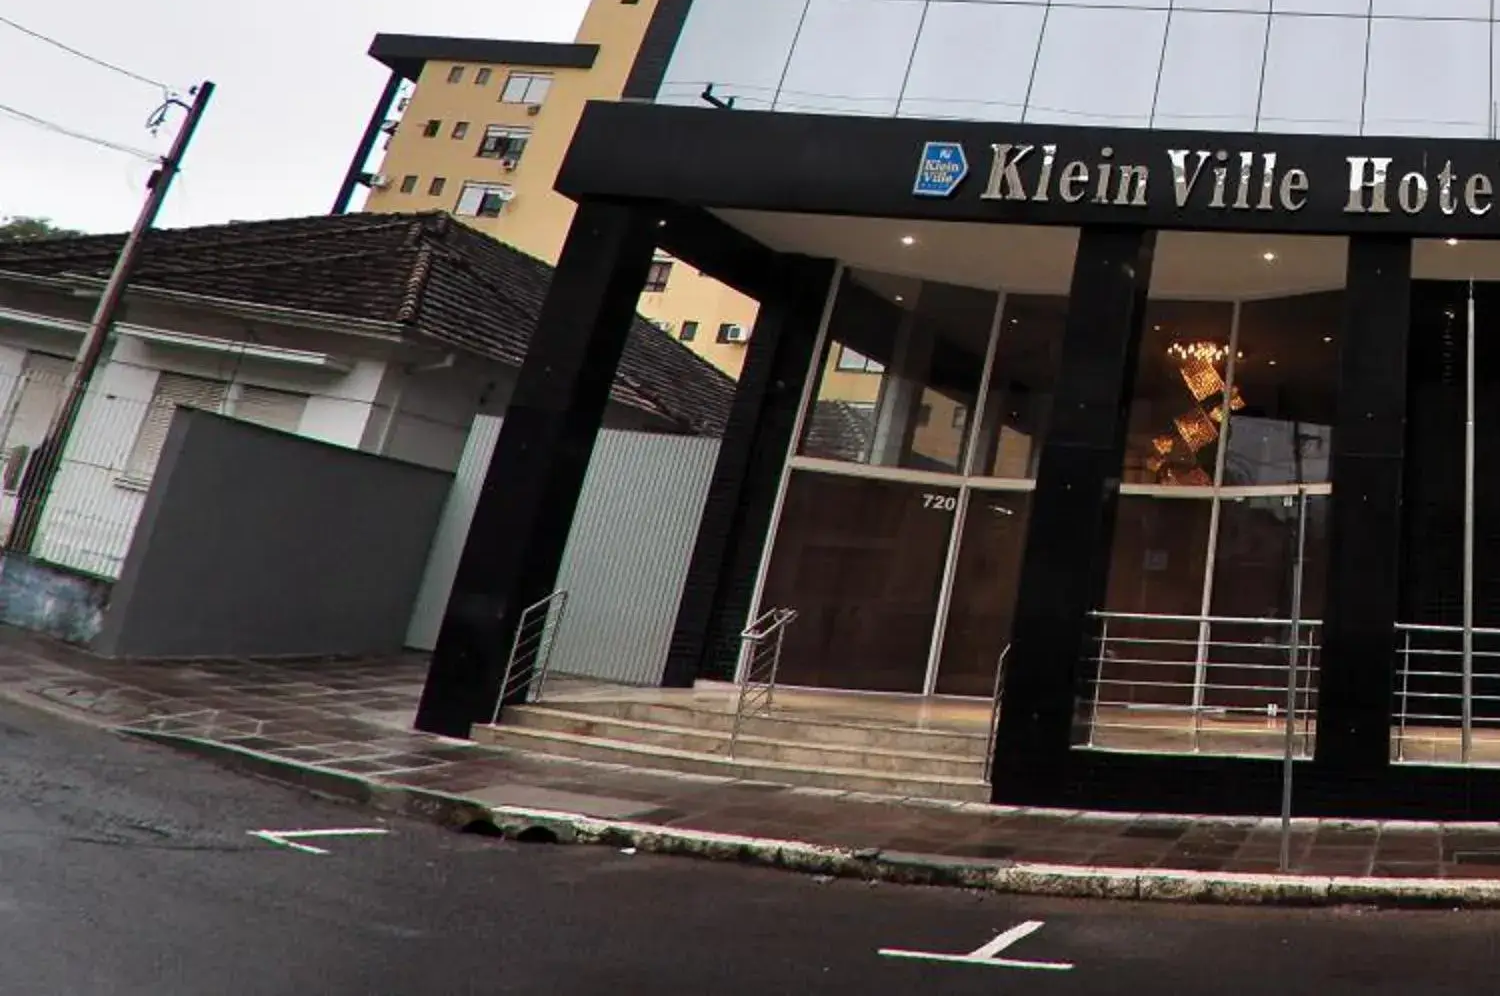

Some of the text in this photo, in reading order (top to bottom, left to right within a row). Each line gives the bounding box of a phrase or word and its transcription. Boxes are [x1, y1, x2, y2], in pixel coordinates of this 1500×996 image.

[979, 143, 1149, 205] Klein
[1167, 149, 1309, 211] Ville
[922, 493, 956, 511] 720
